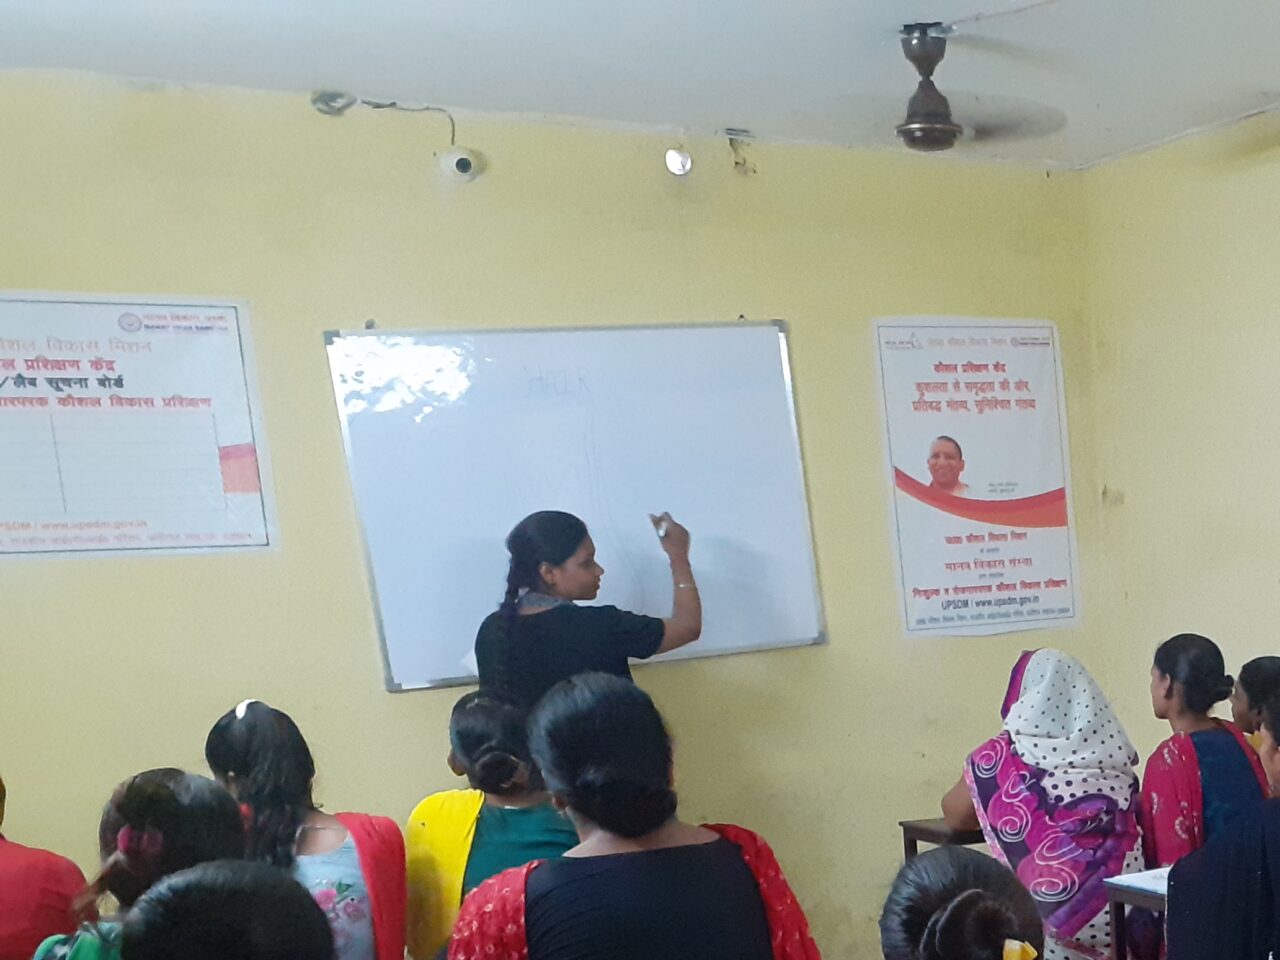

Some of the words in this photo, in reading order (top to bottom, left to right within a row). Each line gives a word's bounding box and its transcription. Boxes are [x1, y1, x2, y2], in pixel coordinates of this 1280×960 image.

[24, 354, 81, 371] प्रशिक्षण
[96, 373, 125, 389] बोर्ड
[110, 394, 154, 408] विकास
[162, 394, 212, 408] प्रशिक्षण
